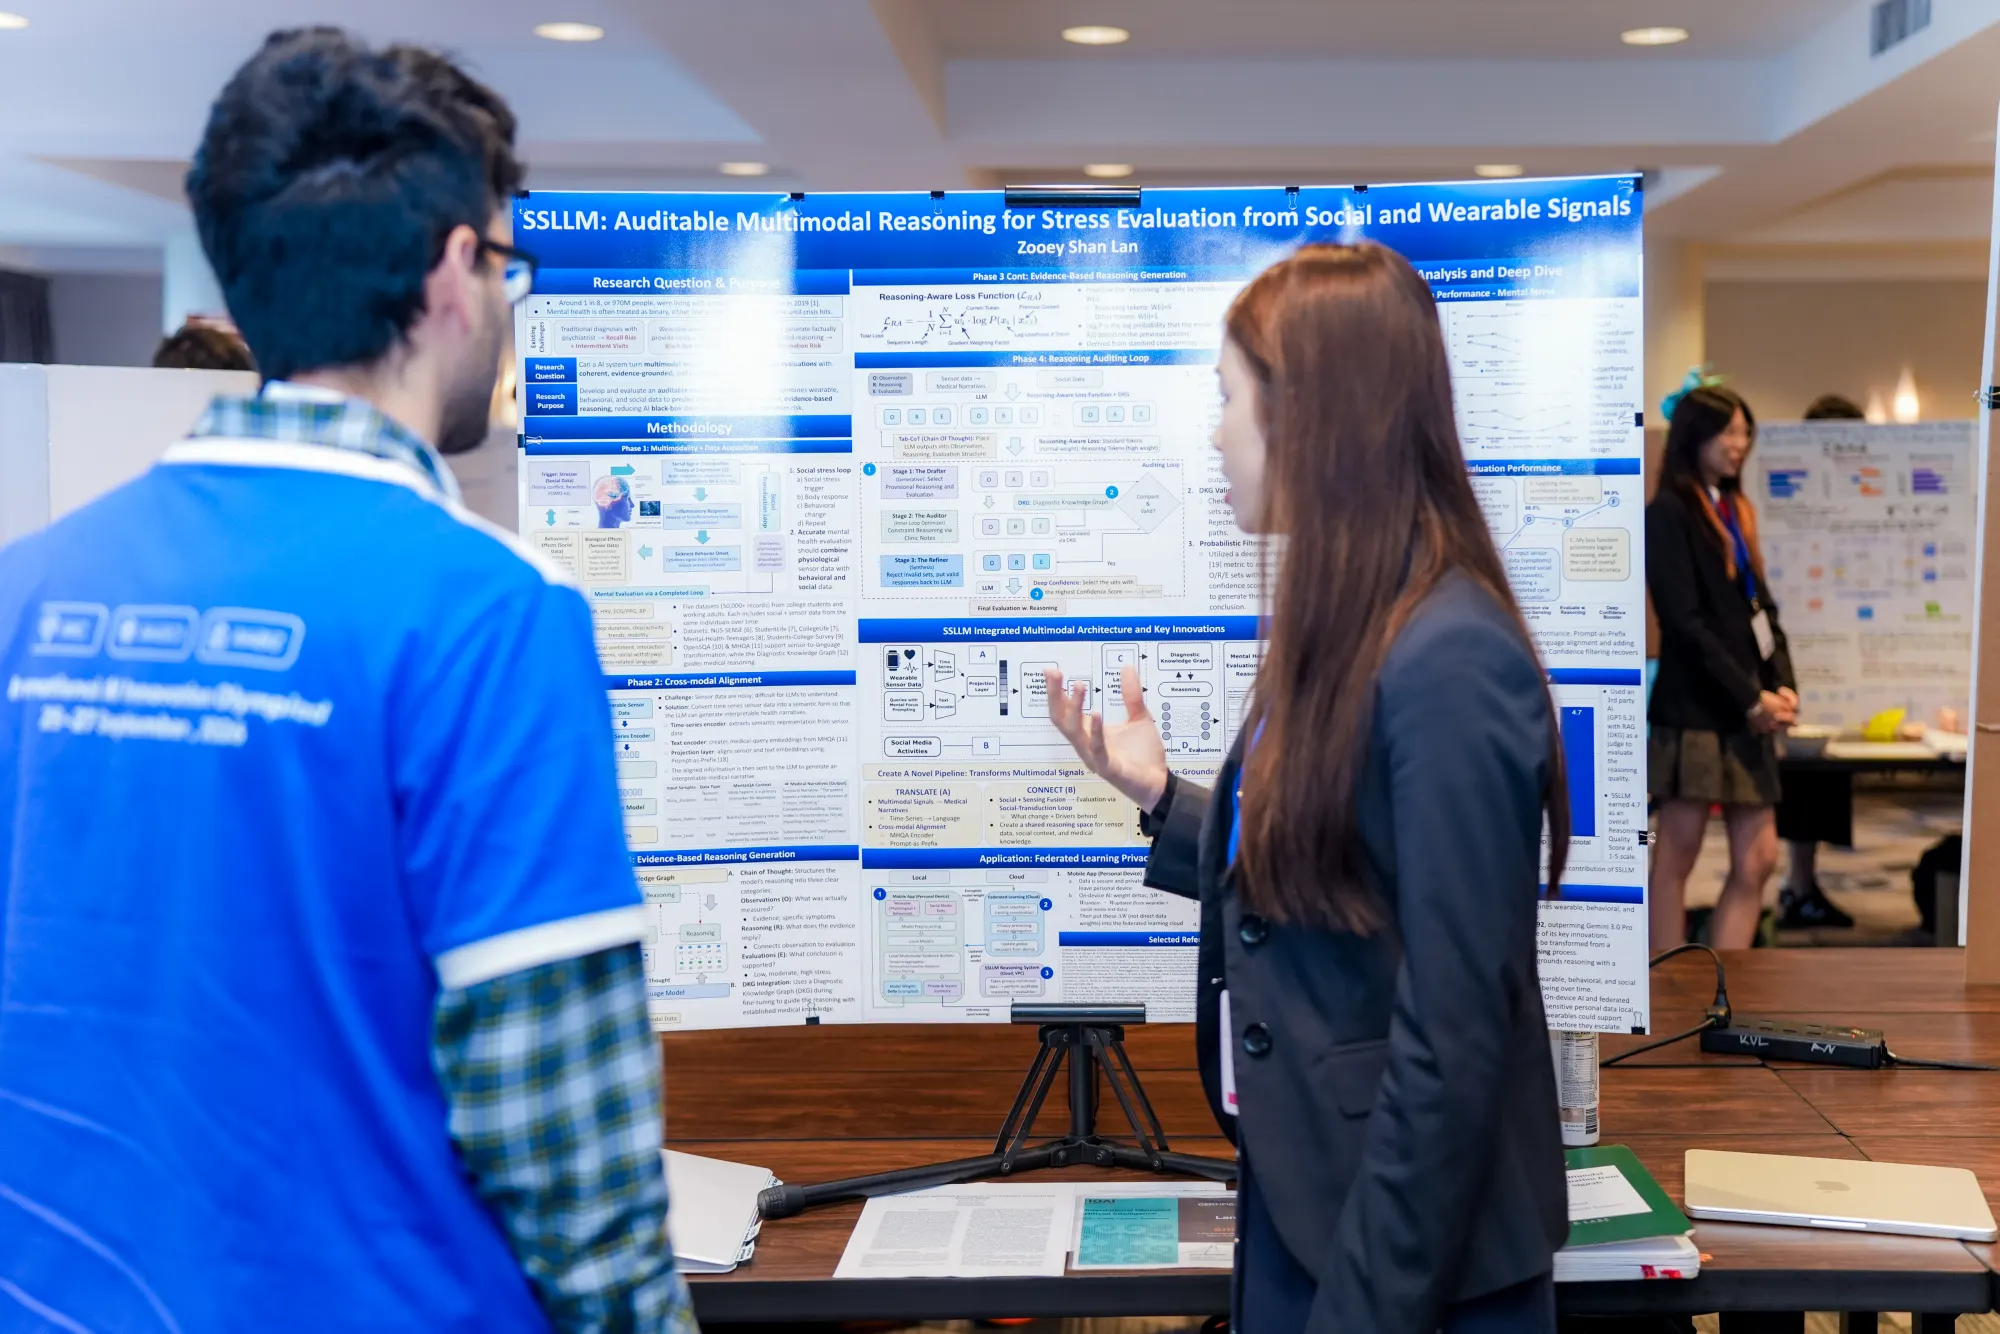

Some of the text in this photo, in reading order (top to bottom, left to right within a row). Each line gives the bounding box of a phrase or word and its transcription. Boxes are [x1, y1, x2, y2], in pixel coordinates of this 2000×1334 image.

[522, 195, 1631, 234] SSLLM: Auditable Multimodal Reasoning for Stress Evaluation from Social and Wearable Signals
[1017, 239, 1138, 257] Zooey Shan Lan
[973, 270, 1186, 281] Phase 3 Cont: Evidence-Based Reasoning Generation
[1418, 264, 1562, 282] Analysis and Deep Dive
[593, 277, 650, 289] Research
[653, 277, 711, 290] Question
[715, 278, 725, 289] &
[879, 293, 952, 301] Reasoning-Aware
[1437, 289, 1490, 299] Performance
[1497, 288, 1528, 297] Mental
[1012, 353, 1149, 365] Phase 4: Reasoning Auditing Loop
[647, 421, 731, 433] Methodology
[1507, 464, 1561, 472] Performance
[943, 624, 1225, 636] SSLLM Integrated Multimodal Architecture and Key Innovations
[1118, 654, 1123, 662] C
[627, 678, 652, 686] Phase
[664, 676, 716, 685] Cross-modal
[718, 675, 761, 685] Alignment
[983, 741, 989, 749] B
[1182, 741, 1188, 749] D
[1058, 769, 1084, 777] Signals
[939, 788, 950, 796] (A)
[1065, 786, 1075, 794] (B)
[637, 850, 796, 863] Evidence-Based Reasoning Generation
[979, 853, 1148, 864] Application: Federated Learning Privac
[1740, 1034, 1769, 1046] KVL
